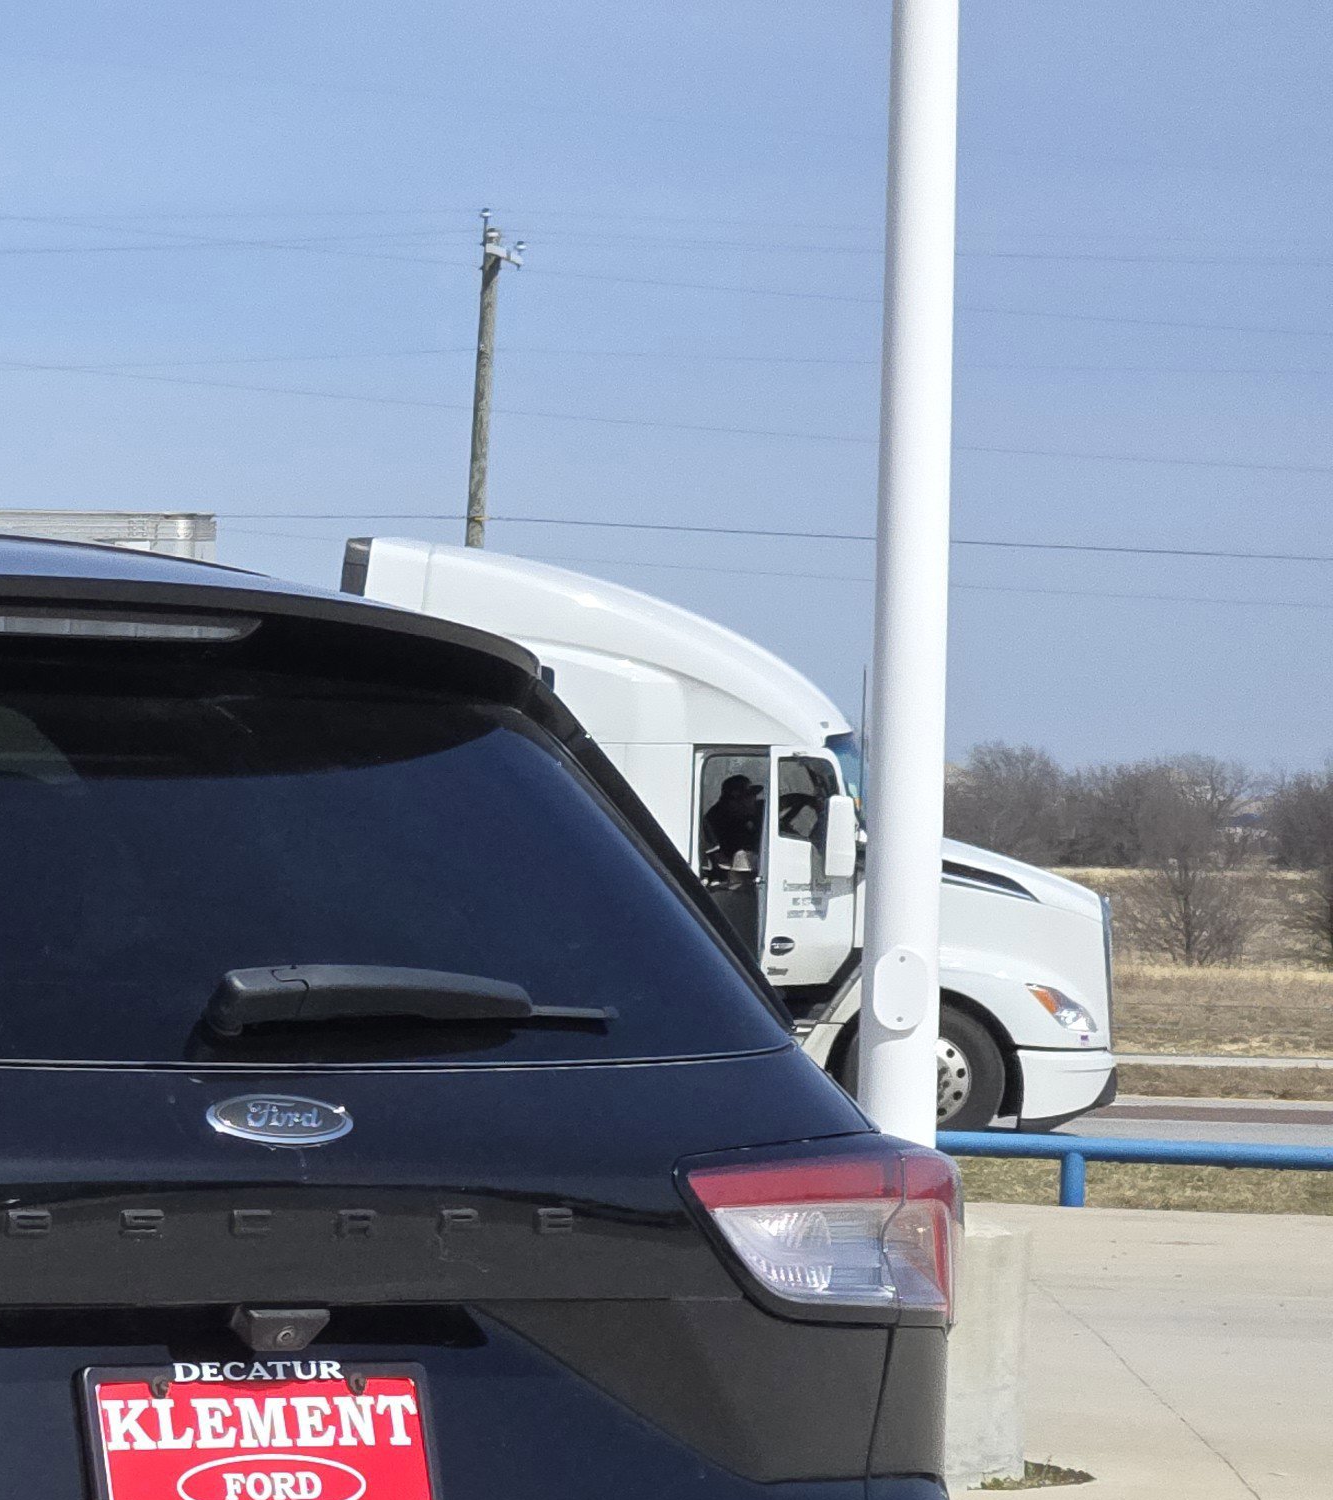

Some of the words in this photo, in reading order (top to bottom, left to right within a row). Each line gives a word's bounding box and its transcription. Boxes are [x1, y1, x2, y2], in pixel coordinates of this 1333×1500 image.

[246, 1100, 323, 1128] Ford
[5, 1207, 575, 1238] ESCAPE
[173, 1360, 345, 1383] DECATUR
[101, 1395, 417, 1451] KLEMENT
